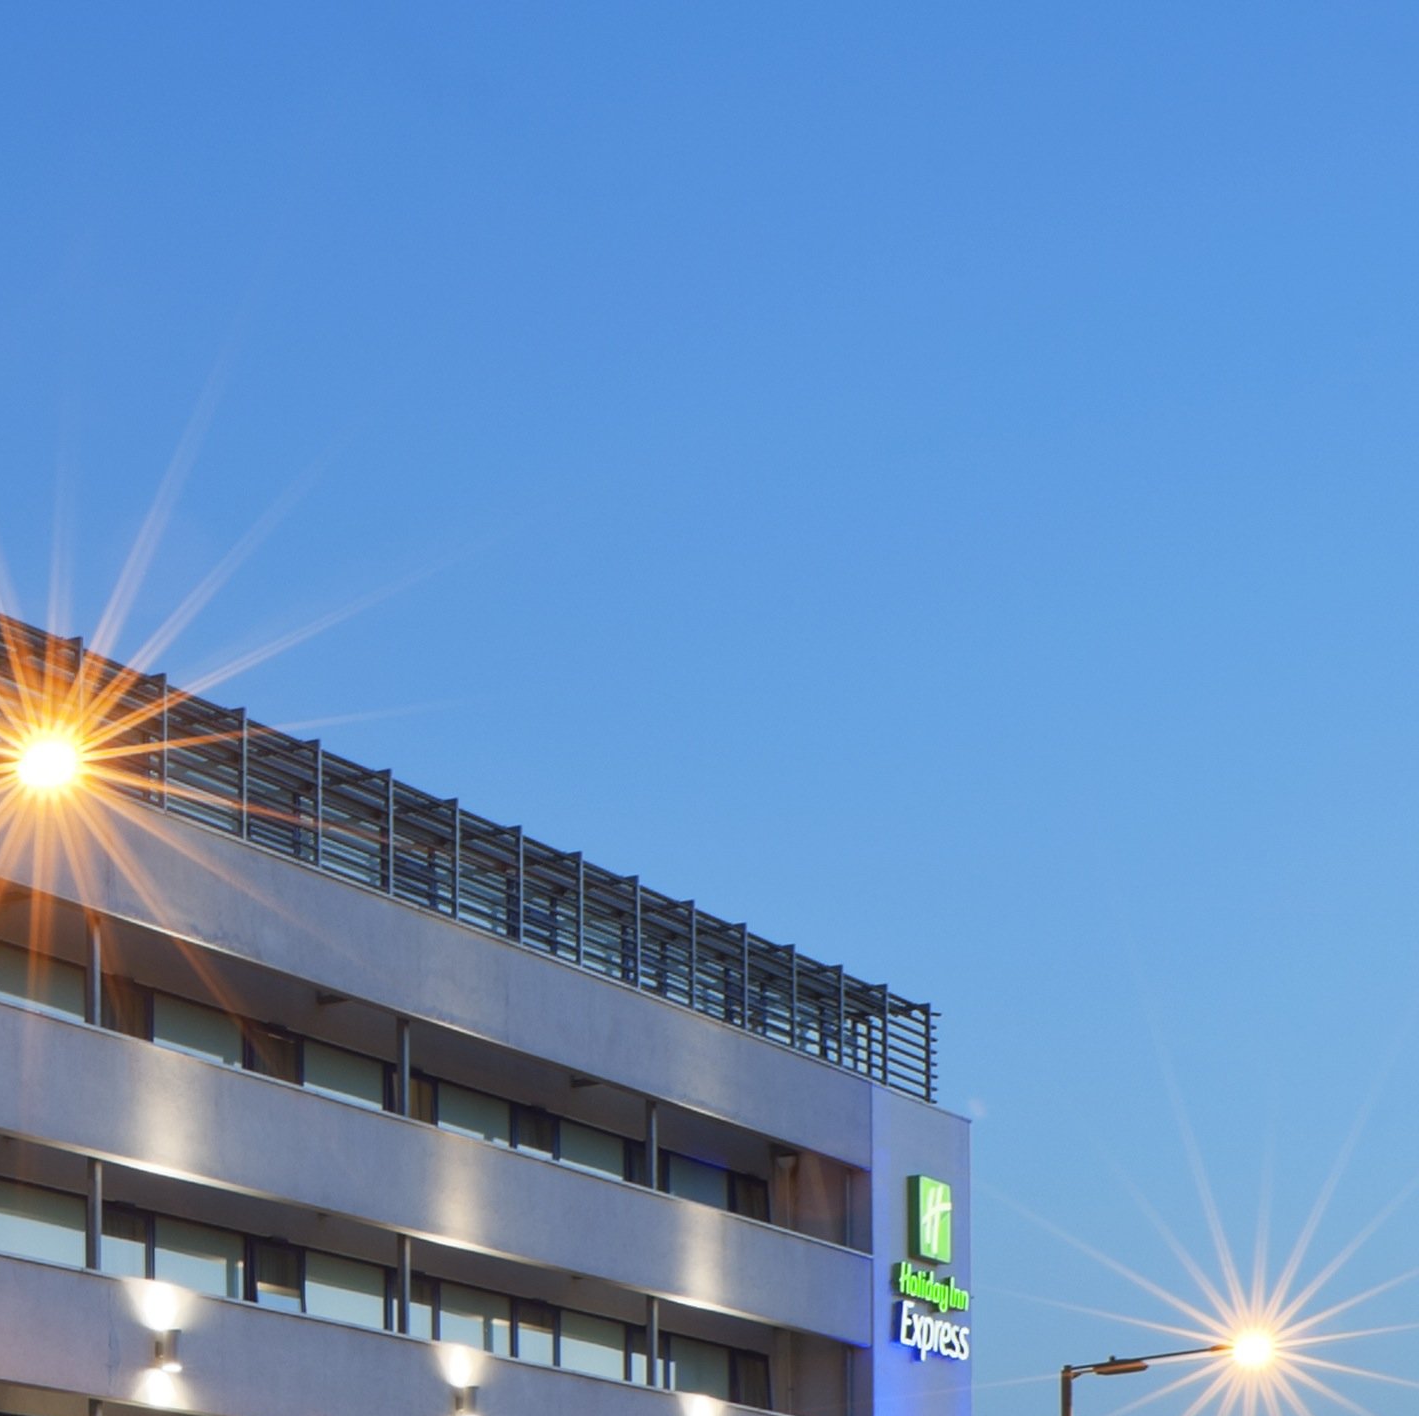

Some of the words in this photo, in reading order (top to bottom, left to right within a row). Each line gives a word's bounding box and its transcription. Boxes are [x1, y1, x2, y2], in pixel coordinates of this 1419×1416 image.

[899, 1261, 949, 1313] Holiday
[950, 1276, 969, 1311] Inn
[900, 1300, 970, 1361] Express
